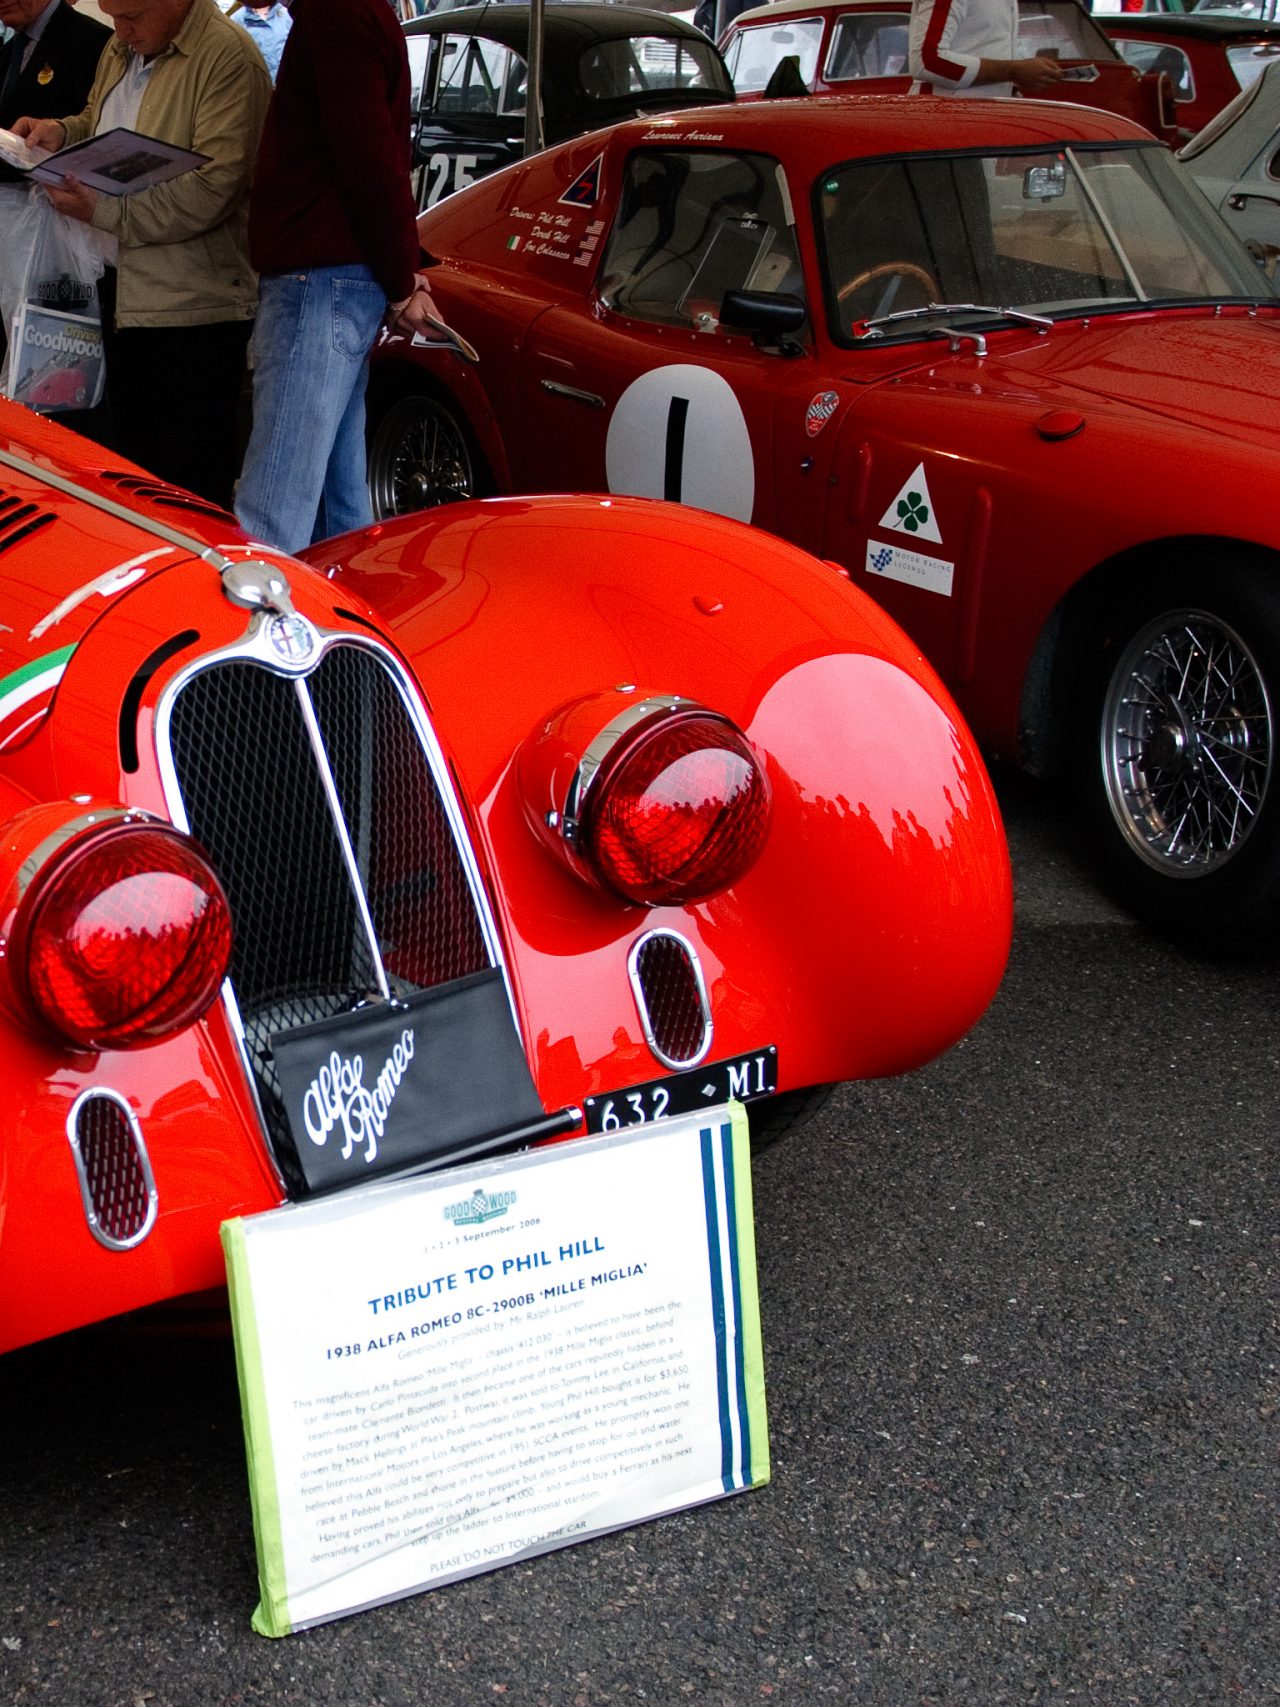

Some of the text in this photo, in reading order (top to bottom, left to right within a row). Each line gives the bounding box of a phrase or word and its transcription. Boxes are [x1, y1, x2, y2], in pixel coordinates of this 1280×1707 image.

[555, 215, 572, 227] Hill
[553, 231, 571, 244] Hill
[894, 551, 952, 573] MOTOR RACING
[346, 1029, 414, 1163] Romeo
[445, 1201, 470, 1220] GOOD
[489, 1191, 516, 1212] WOOD
[463, 1225, 515, 1242] September
[520, 1218, 540, 1228] 2006
[368, 1237, 605, 1314] TRIBUTE TO PHIL HILL
[328, 1344, 361, 1359] 1938
[368, 1332, 405, 1351] ALFA
[411, 1313, 461, 1338] ROMEO
[467, 1293, 535, 1319] 8C-2900B
[430, 1556, 461, 1572] PLEASE
[463, 1549, 480, 1562] DO
[484, 1543, 505, 1556] NOT
[508, 1536, 545, 1548] TOUCH
[567, 1521, 586, 1532] CAR
